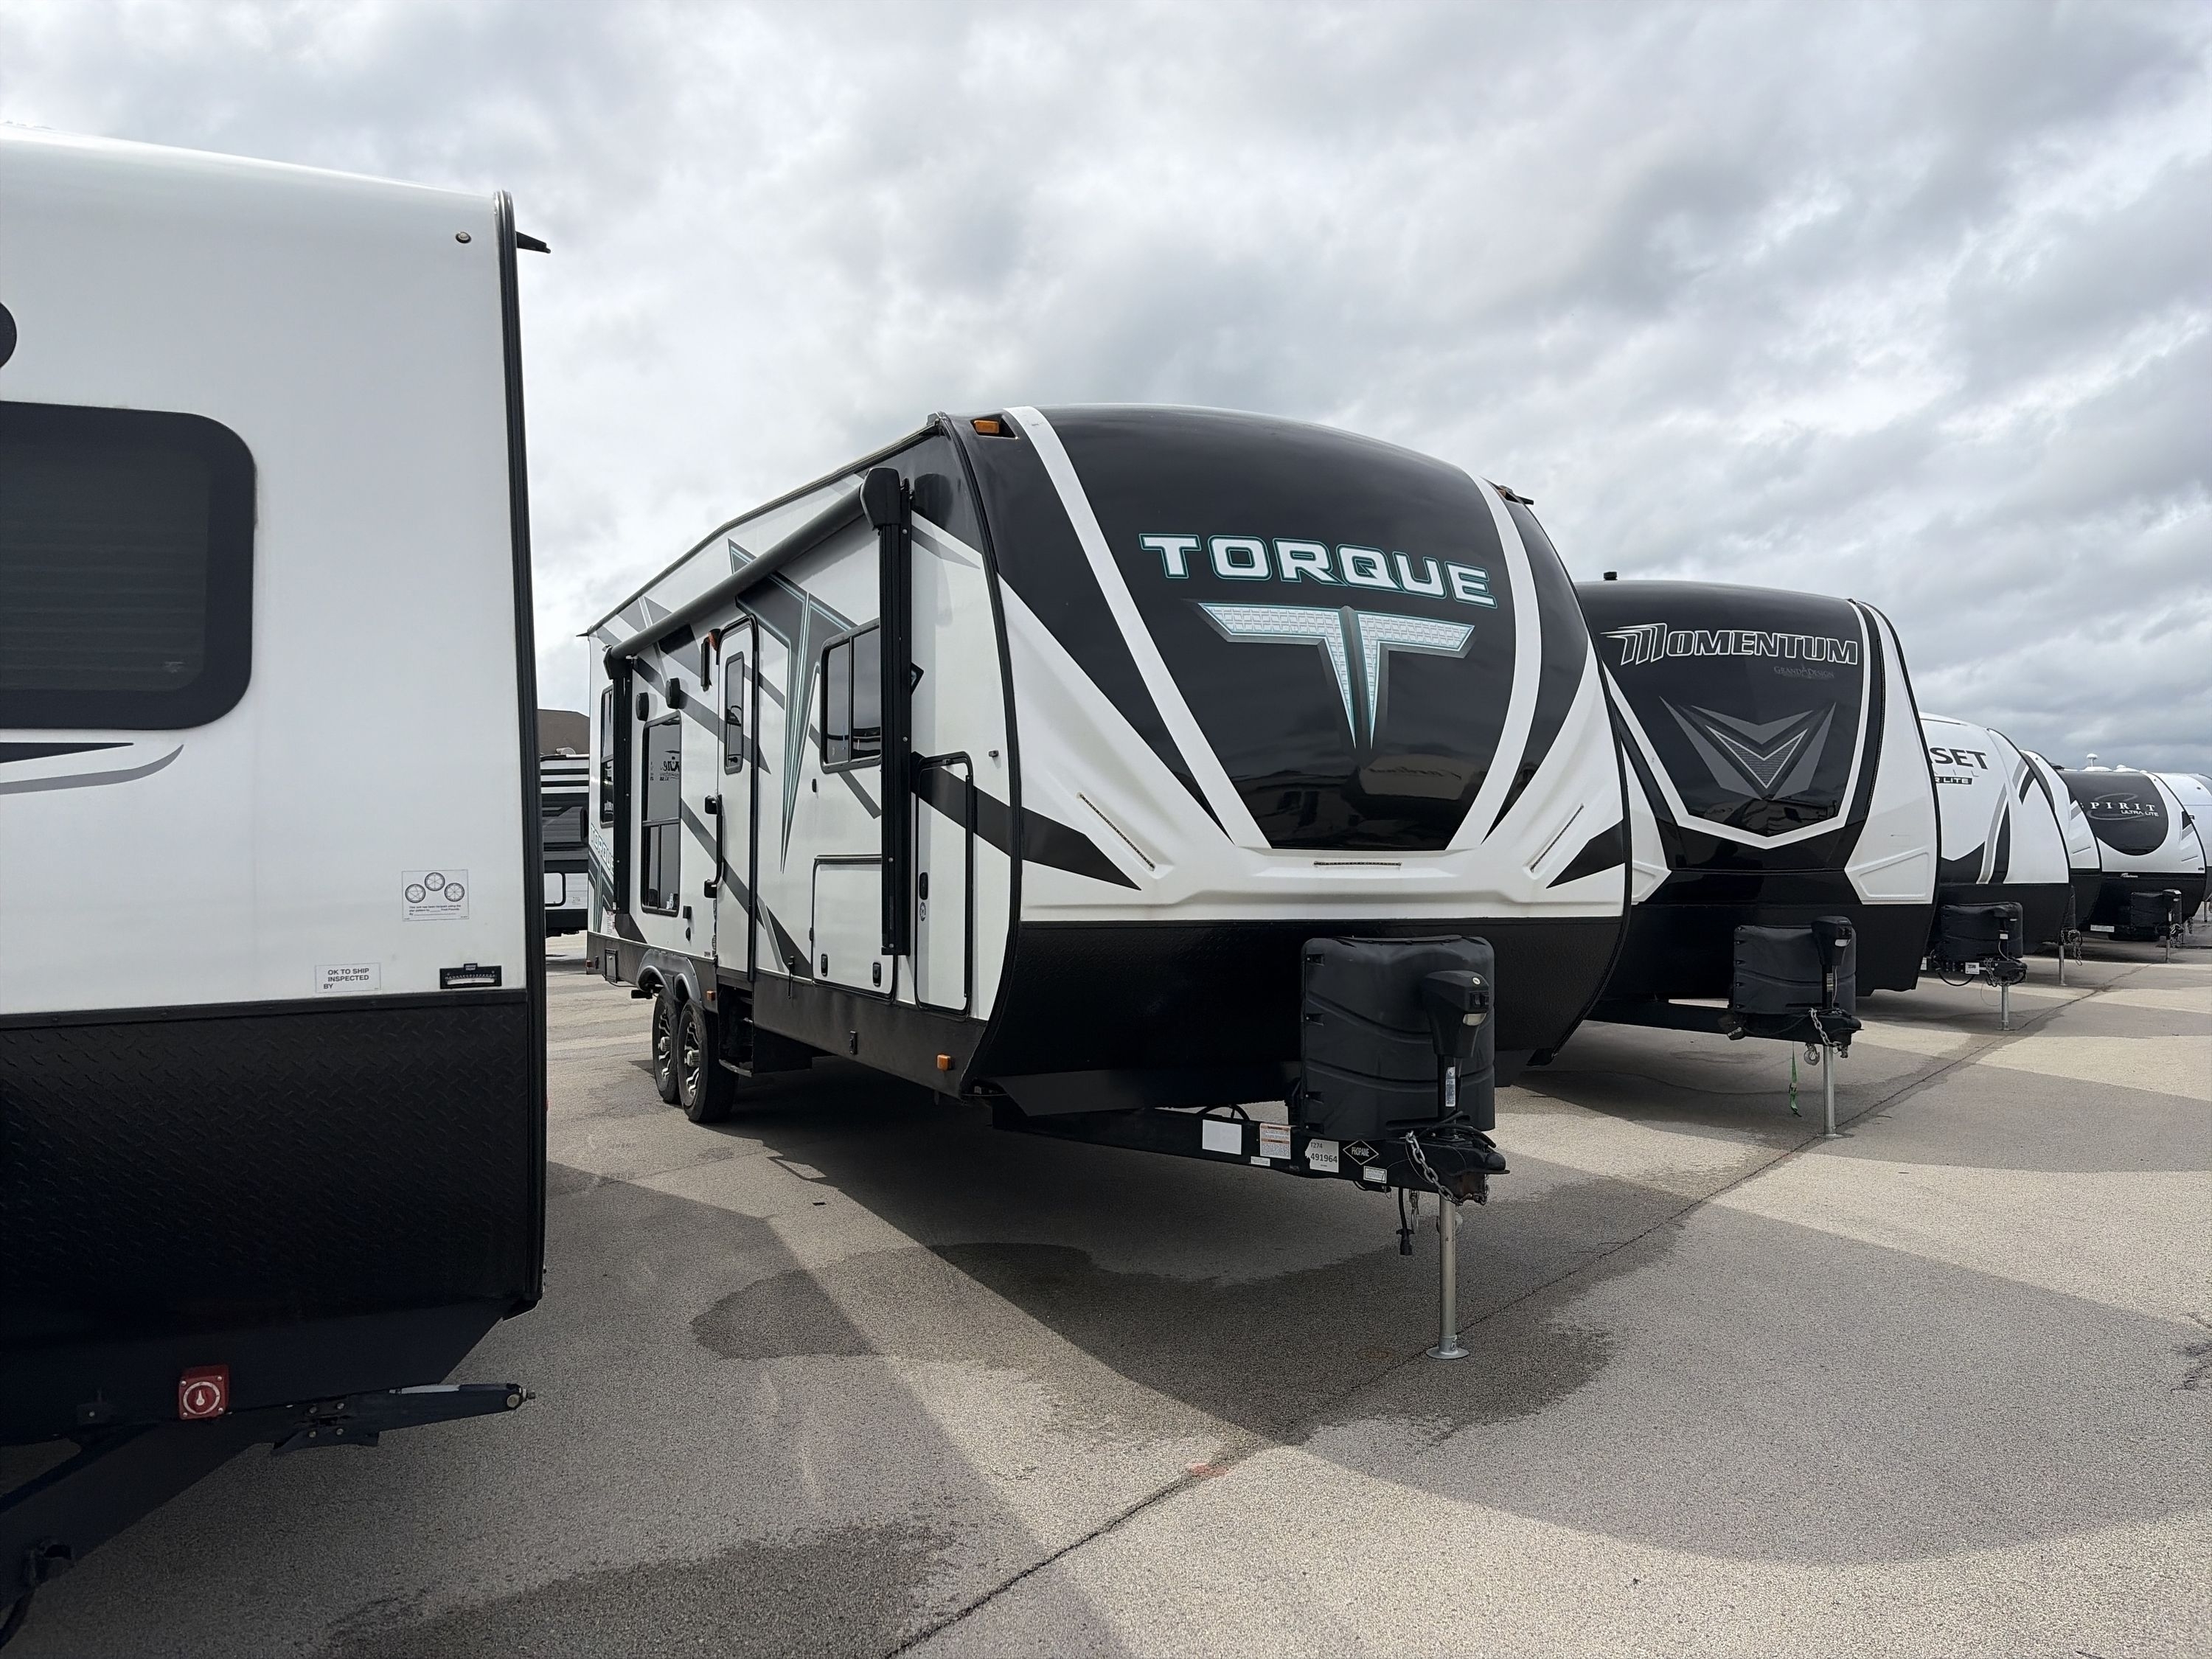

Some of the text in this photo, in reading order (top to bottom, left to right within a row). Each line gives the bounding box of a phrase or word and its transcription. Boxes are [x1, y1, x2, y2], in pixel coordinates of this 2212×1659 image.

[1138, 533, 1498, 609] TORQUE
[1600, 622, 1859, 666] MOMENTUM
[1930, 747, 1989, 770] SET
[1310, 1152, 1338, 1164] 491964
[1352, 1147, 1370, 1157] PROPANE
